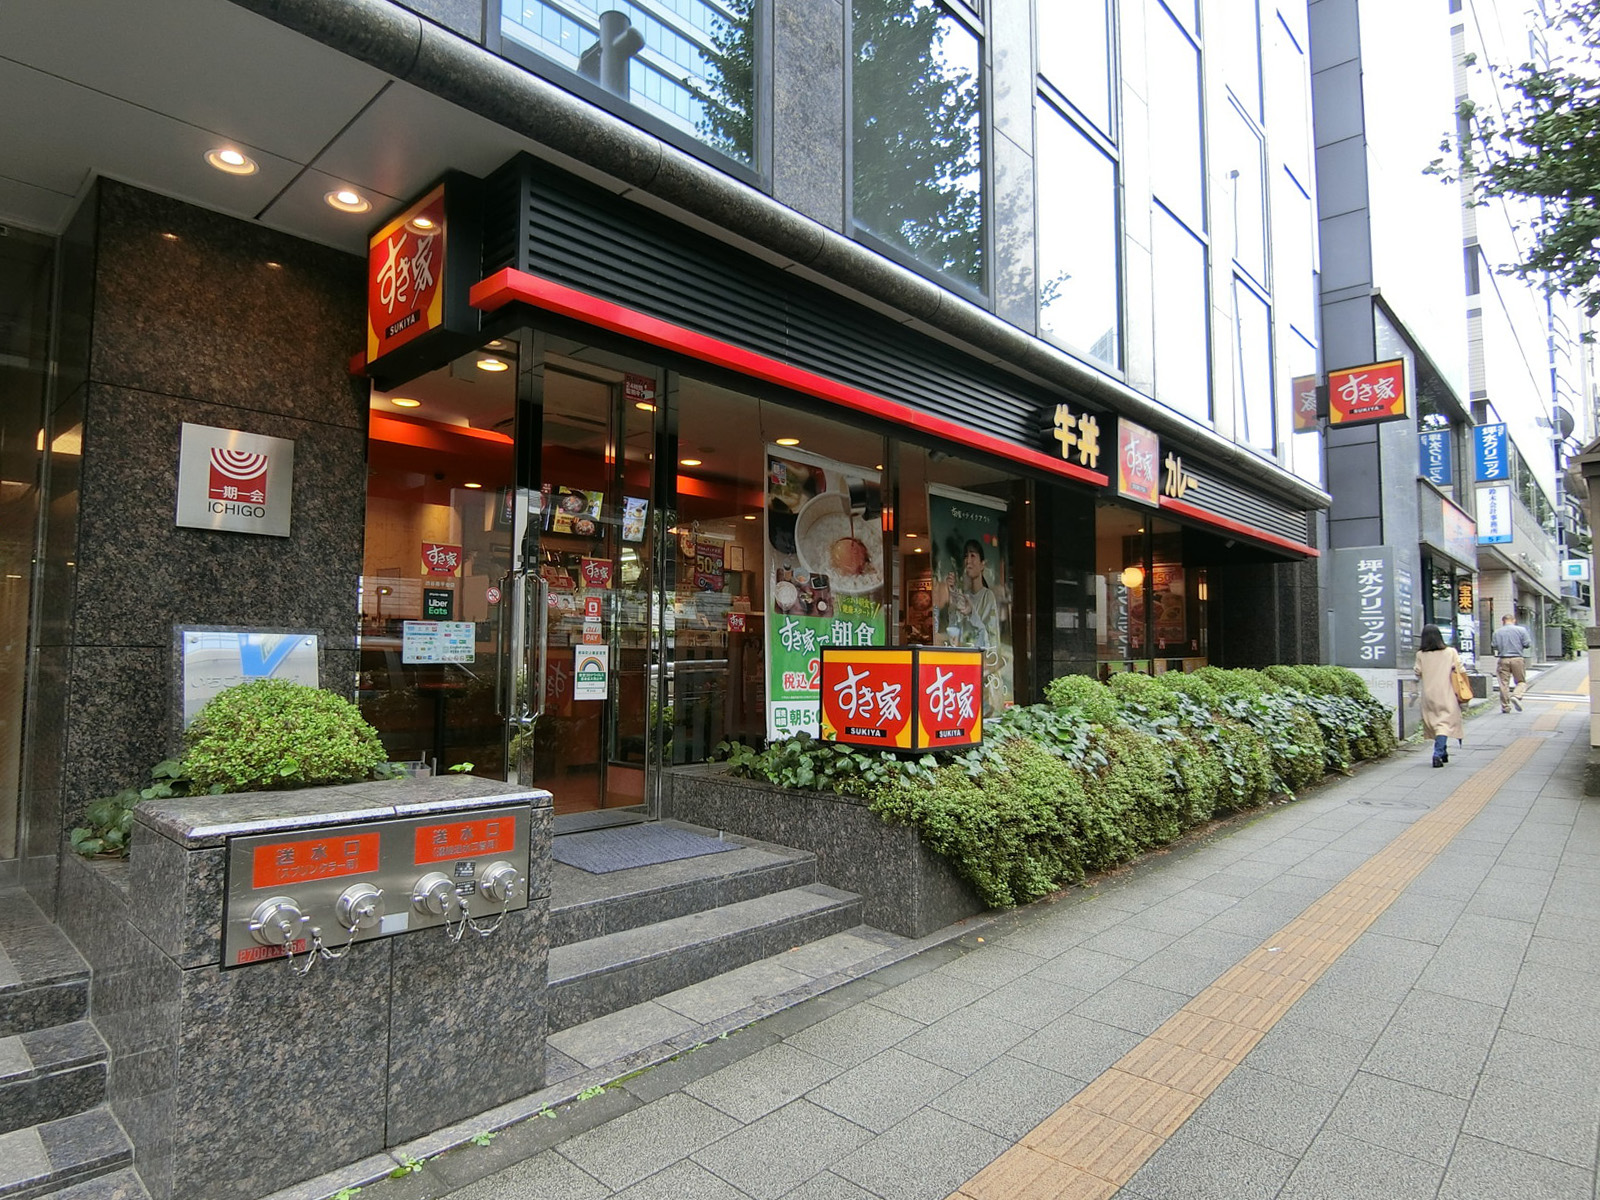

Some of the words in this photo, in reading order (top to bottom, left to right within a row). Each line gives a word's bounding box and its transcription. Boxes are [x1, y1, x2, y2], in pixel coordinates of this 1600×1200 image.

[377, 233, 433, 314] すき家
[389, 314, 416, 336] SUKIYA
[1337, 374, 1396, 405] すき家
[1053, 403, 1100, 469] 牛丼
[1124, 432, 1153, 481] すき家
[1481, 425, 1500, 478] 坪水クリニック
[1164, 451, 1199, 498] カレー
[210, 485, 264, 503] 一期一会
[208, 501, 266, 518] ICHIGO
[426, 544, 457, 568] すき家
[585, 560, 609, 580] すき家
[428, 599, 448, 607] Uber
[1357, 559, 1385, 644] 坪水クリニック
[1458, 585, 1473, 608] 宝来
[428, 607, 448, 615] Eats
[779, 617, 875, 656] すき家で朝食
[1360, 646, 1386, 660] 3F
[833, 665, 902, 727] すき家
[926, 666, 974, 727] すき家
[850, 727, 881, 737] SUKIYA
[939, 730, 961, 738] SUKIYA
[433, 822, 500, 845] 送水口
[276, 840, 360, 866] 送水口
